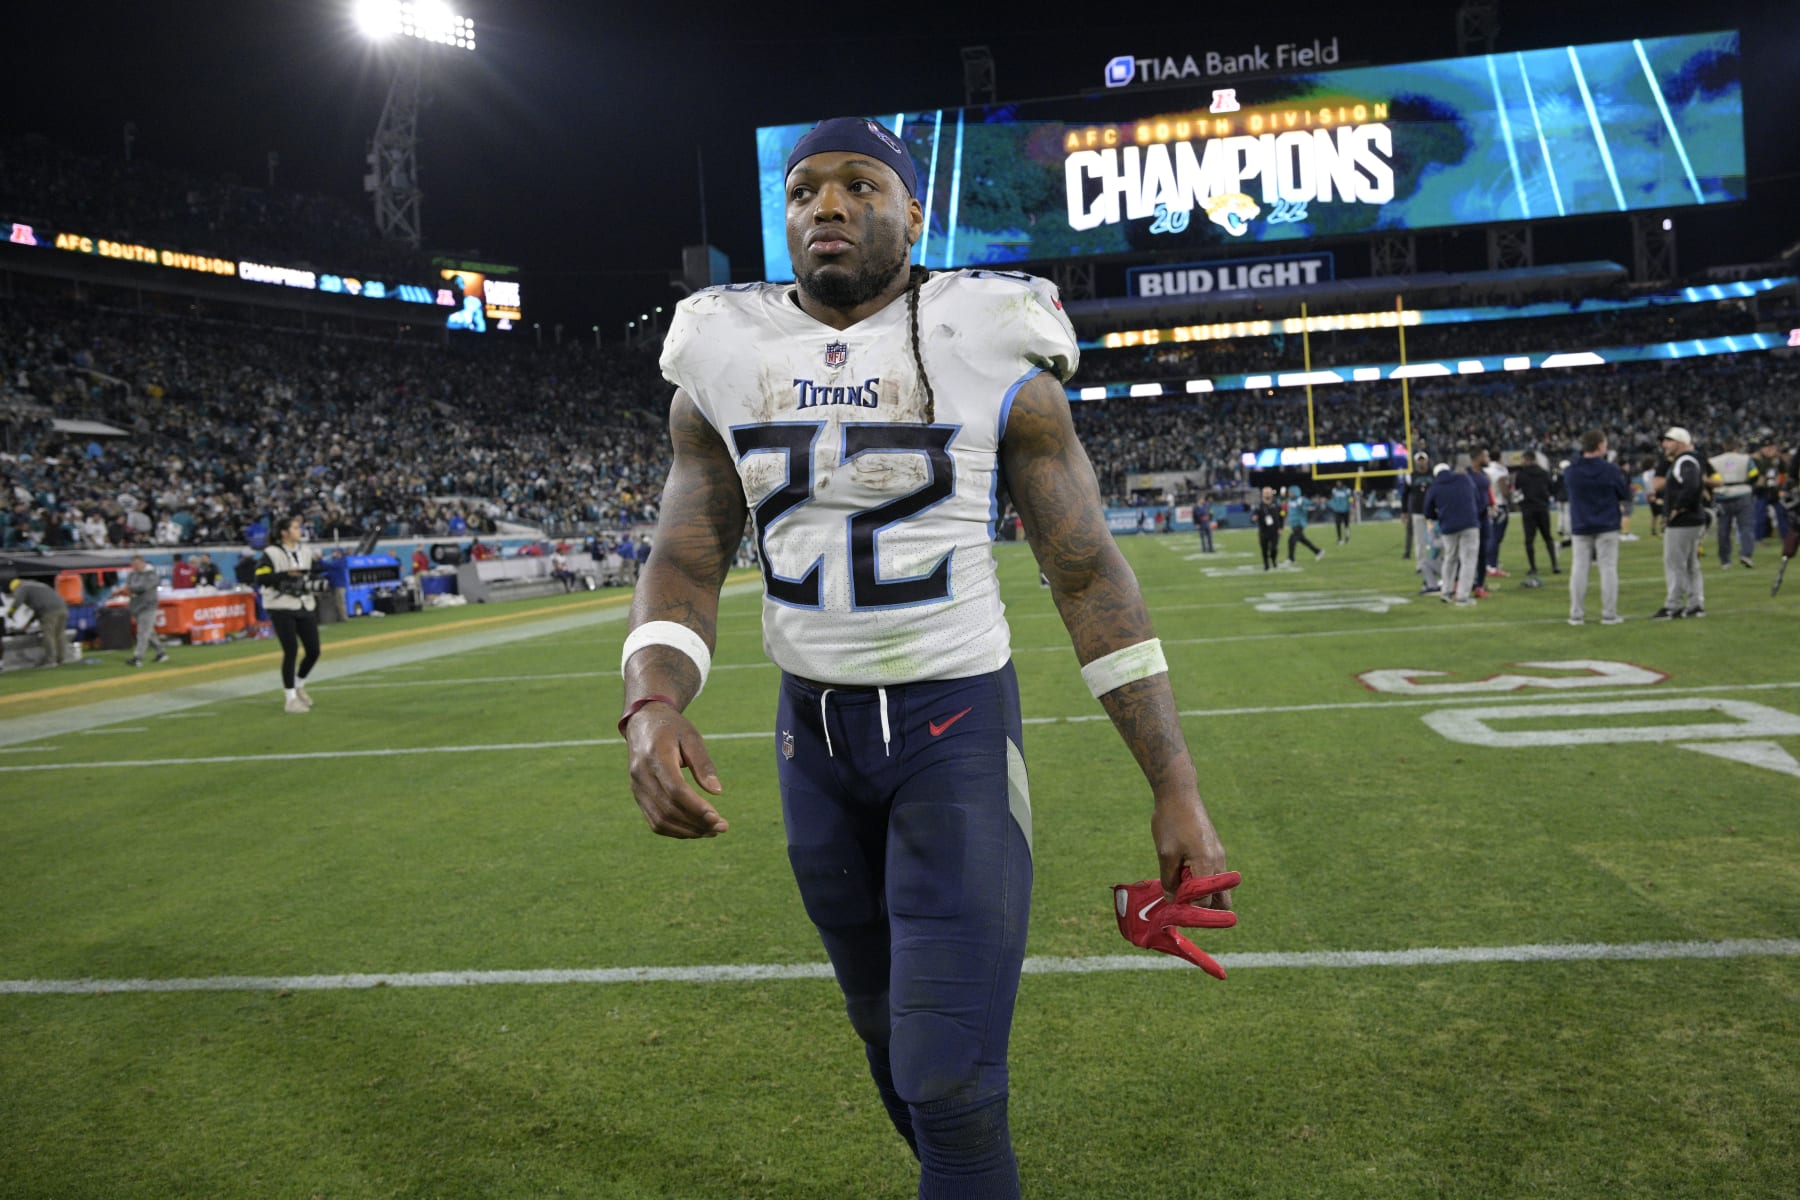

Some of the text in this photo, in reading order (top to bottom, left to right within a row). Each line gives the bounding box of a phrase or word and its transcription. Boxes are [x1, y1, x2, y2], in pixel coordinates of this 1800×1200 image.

[1136, 37, 1339, 83] TIAA Bank Field
[1066, 103, 1388, 148] AFC SOUTH DIVISION
[1065, 123, 1395, 231] CHAMPIONS
[1149, 201, 1190, 234] 20
[56, 233, 93, 253] AFC
[97, 239, 158, 264] SOUTH
[161, 250, 236, 275] DIVISION
[1139, 260, 1322, 298] BUD LIGHT
[1105, 328, 1160, 349] AFC
[1172, 320, 1273, 343] SOUTH
[793, 378, 880, 411] TITANS
[729, 421, 962, 613] 22
[193, 603, 247, 622] GATORADE
